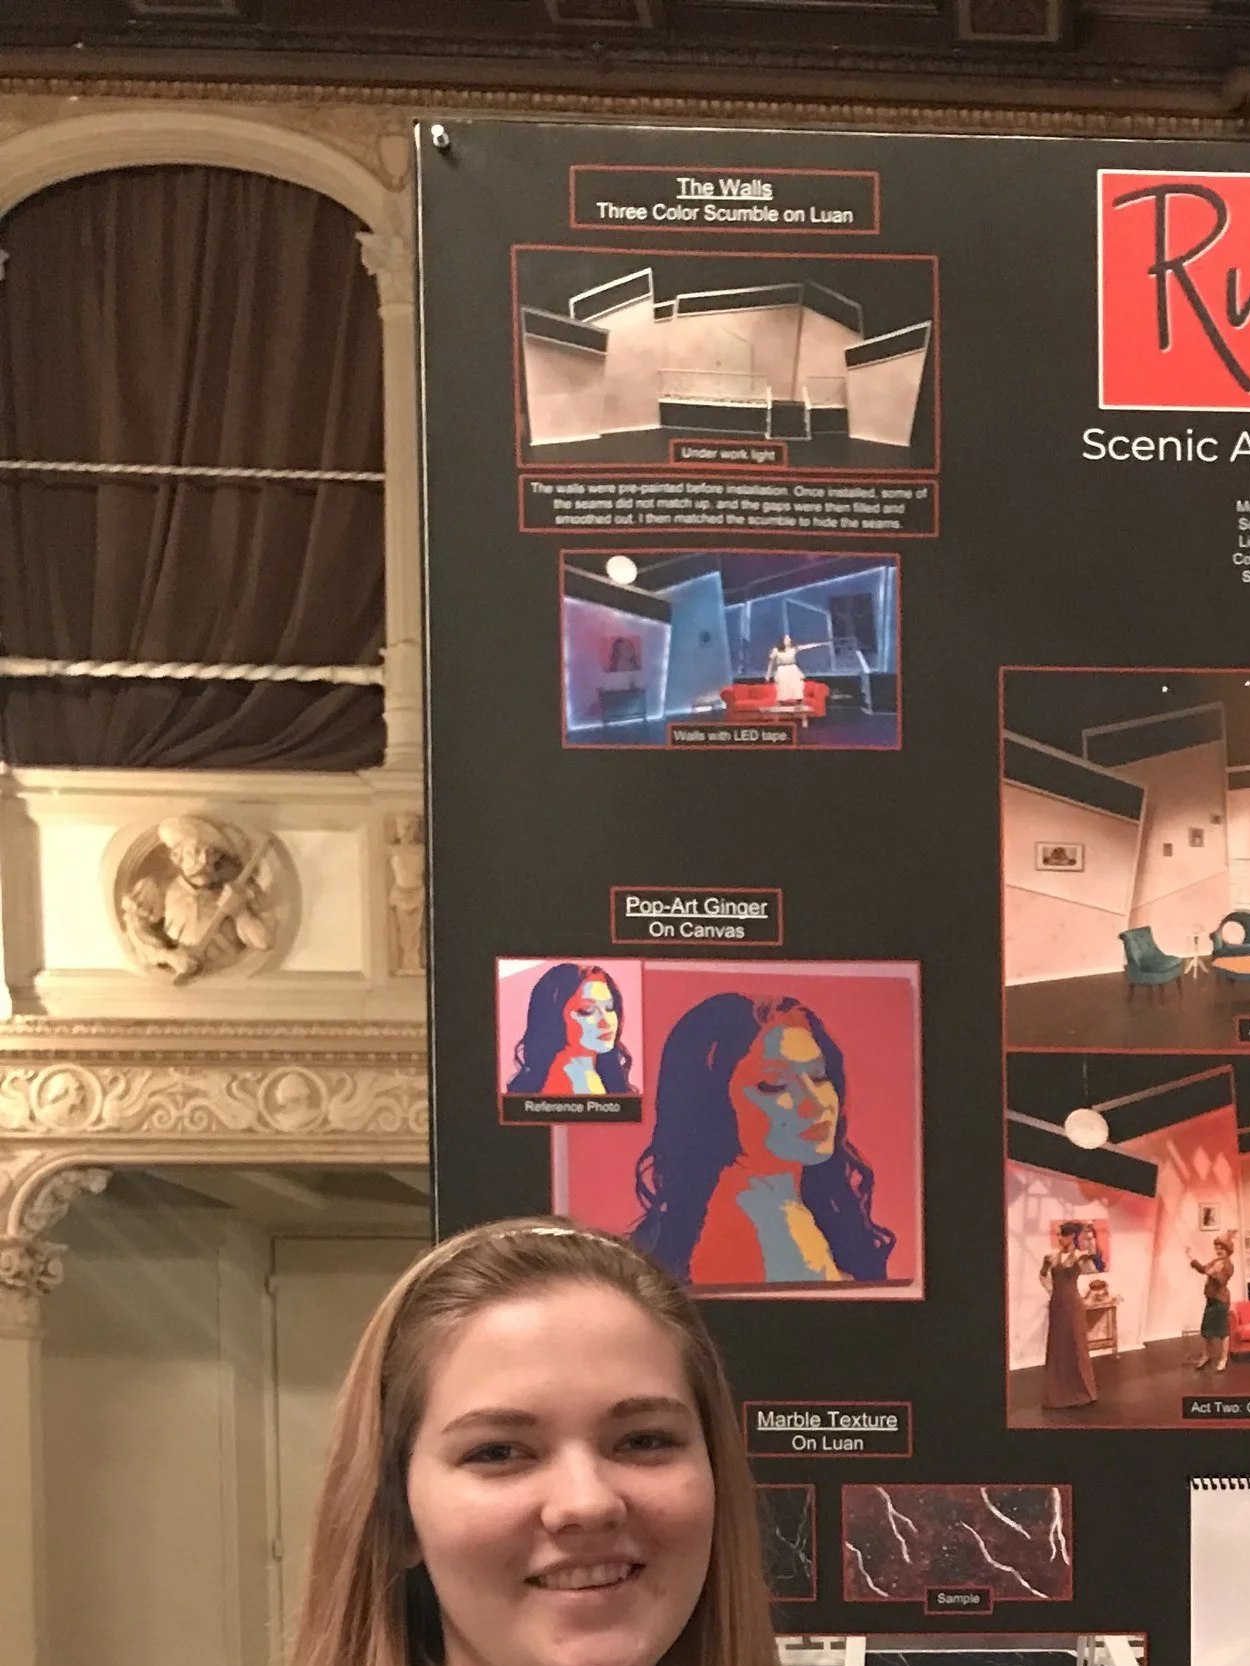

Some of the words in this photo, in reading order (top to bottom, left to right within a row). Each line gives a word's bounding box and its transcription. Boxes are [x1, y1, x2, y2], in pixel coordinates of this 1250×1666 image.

[677, 177, 714, 197] The
[719, 179, 773, 197] Walls
[597, 202, 648, 220] Three
[652, 203, 699, 221] Color
[704, 204, 779, 222] Scumble
[783, 208, 805, 222] on
[810, 207, 854, 223] Luan
[1082, 428, 1218, 463] Scenic
[681, 447, 717, 459] Under
[751, 449, 775, 463] light
[531, 482, 553, 494] The
[673, 730, 705, 742] Walls
[707, 730, 731, 742] with
[734, 730, 758, 742] LED
[626, 897, 698, 917] Pop-Art
[704, 898, 768, 917] Ginger
[649, 921, 674, 937] On
[679, 922, 745, 939] Canvas
[525, 1101, 584, 1113] Reference
[587, 1102, 620, 1114] Photo
[1191, 1402, 1211, 1413] Act
[757, 1411, 821, 1429] Marble
[827, 1412, 898, 1430] Texture
[792, 1435, 818, 1451] On
[822, 1435, 864, 1451] Luan
[937, 1593, 980, 1606] Sample
